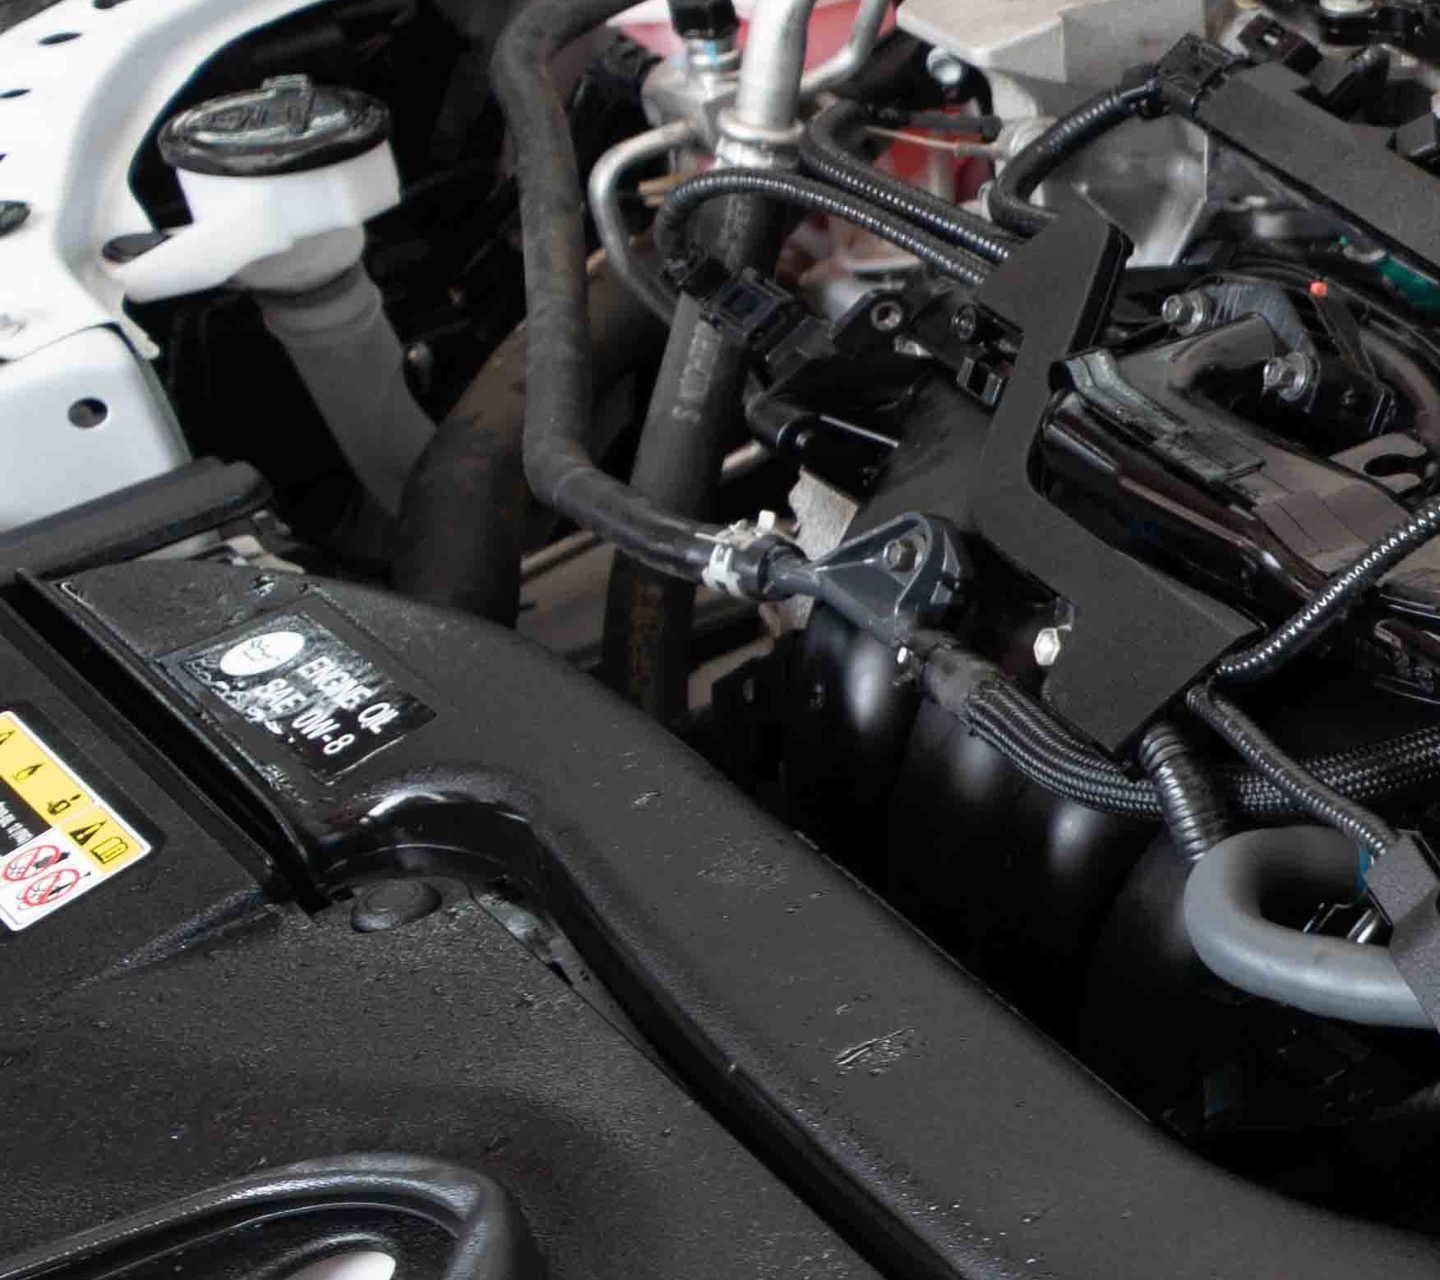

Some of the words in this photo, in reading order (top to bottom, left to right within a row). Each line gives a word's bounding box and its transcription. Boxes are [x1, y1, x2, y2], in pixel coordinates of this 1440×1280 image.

[255, 677, 309, 715] SAE
[291, 709, 355, 756] 0W-8
[297, 656, 375, 711] ENGINE
[357, 701, 399, 734] OIL
